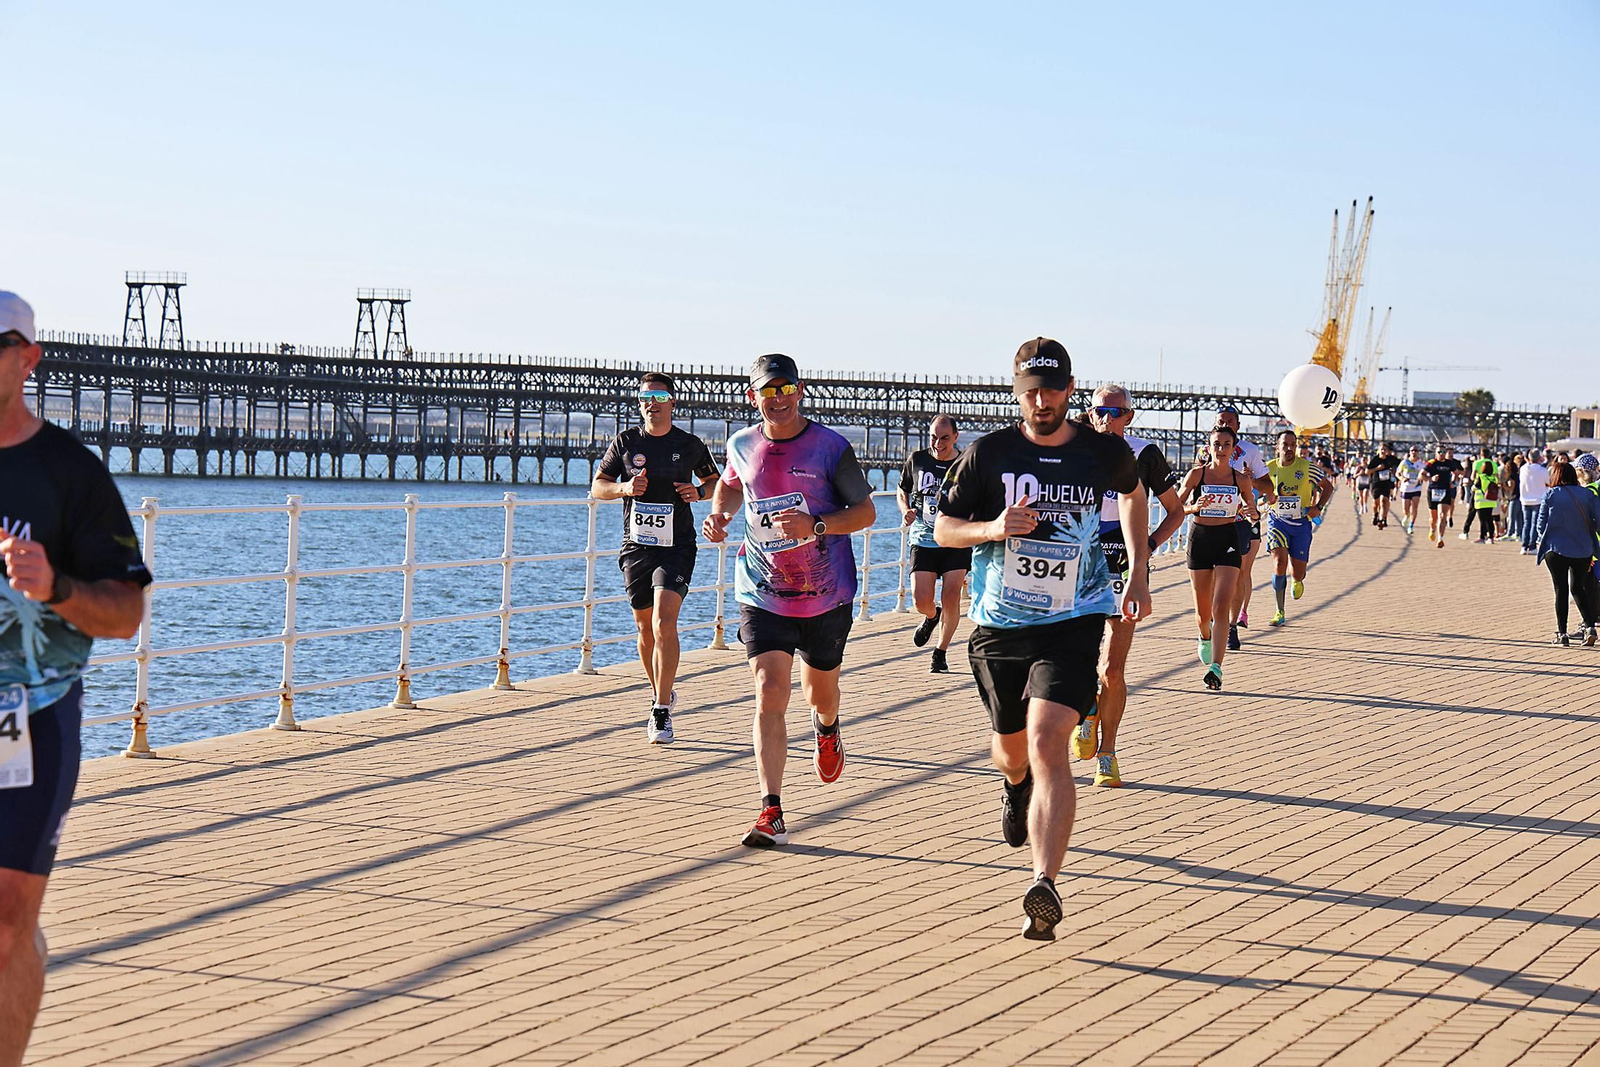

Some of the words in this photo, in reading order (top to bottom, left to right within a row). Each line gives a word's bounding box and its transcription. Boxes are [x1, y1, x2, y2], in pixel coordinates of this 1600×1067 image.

[1020, 356, 1059, 371] adidas
[1321, 386, 1338, 409] 10
[1001, 472, 1039, 509] 10
[1038, 483, 1095, 505] HUELVA
[1208, 493, 1233, 504] 273
[1279, 502, 1297, 510] 234
[635, 513, 666, 528] 845
[1062, 548, 1076, 558] '24
[1016, 556, 1066, 581] 394
[1013, 590, 1048, 603] Wayalia
[0, 712, 21, 741] 4
